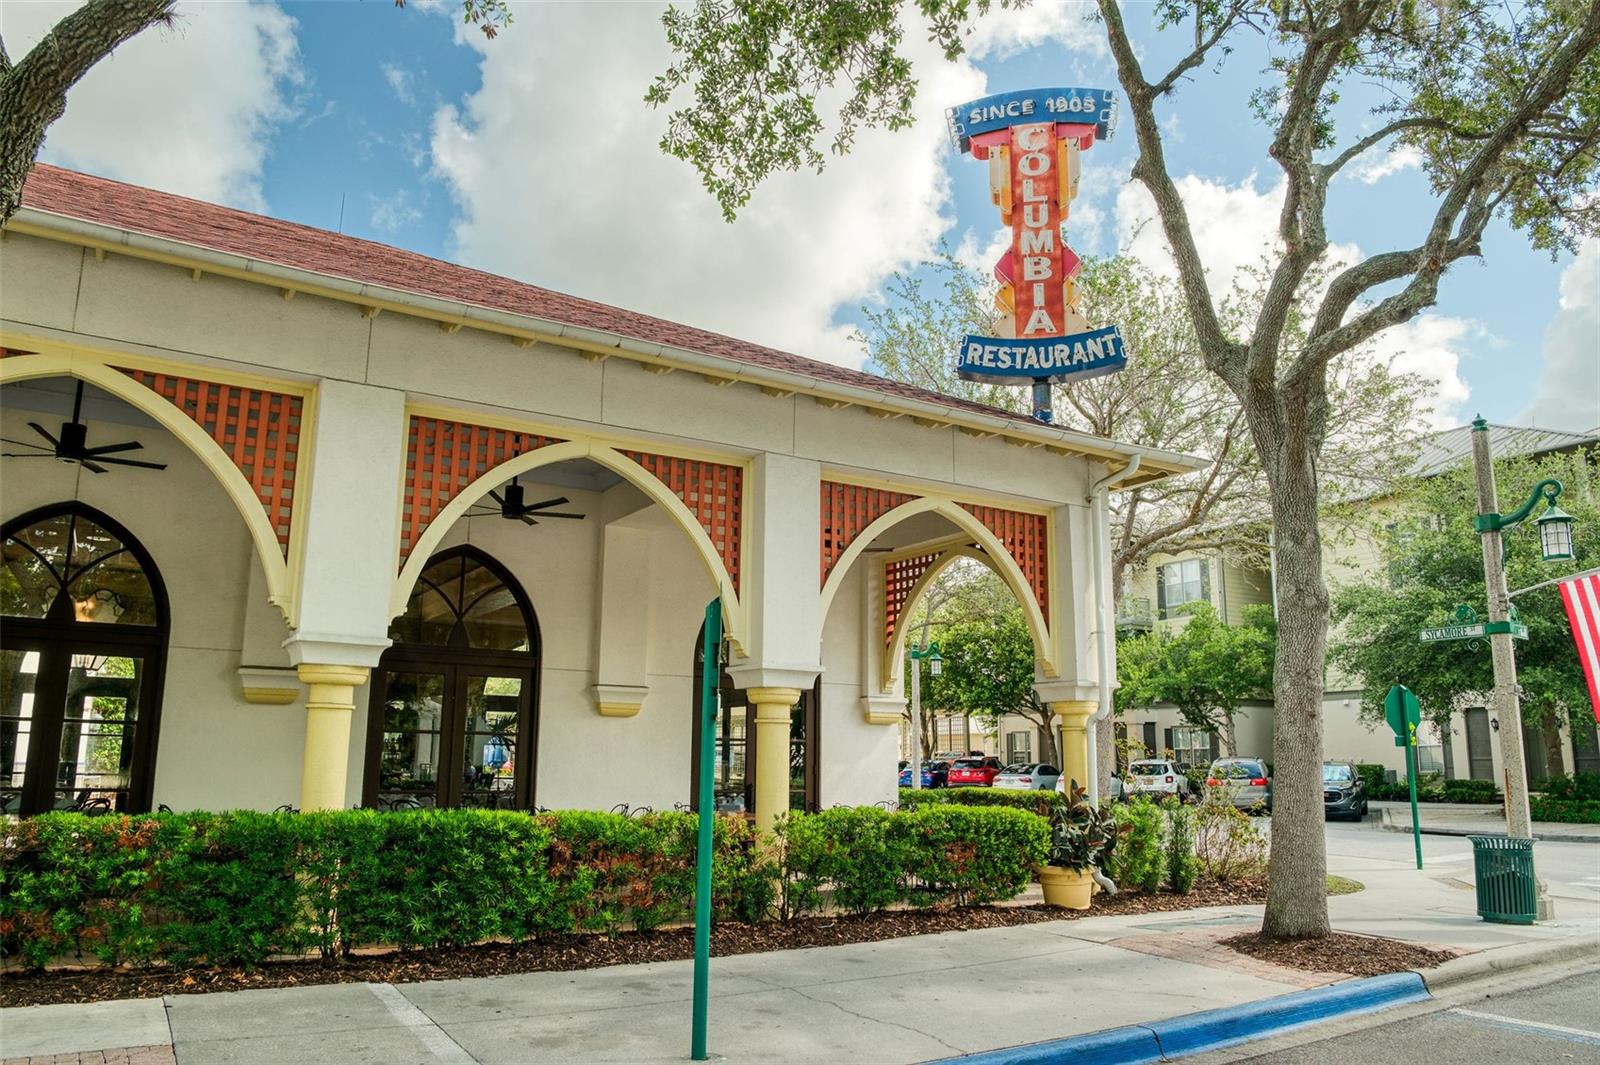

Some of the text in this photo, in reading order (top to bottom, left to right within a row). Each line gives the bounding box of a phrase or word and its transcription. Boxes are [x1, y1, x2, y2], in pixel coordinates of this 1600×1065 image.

[968, 96, 1096, 124] SINCE 1905
[1018, 126, 1057, 335] COLUMBIA
[967, 333, 1117, 370] RESTAURANT
[1425, 626, 1468, 640] SYCAMORE
